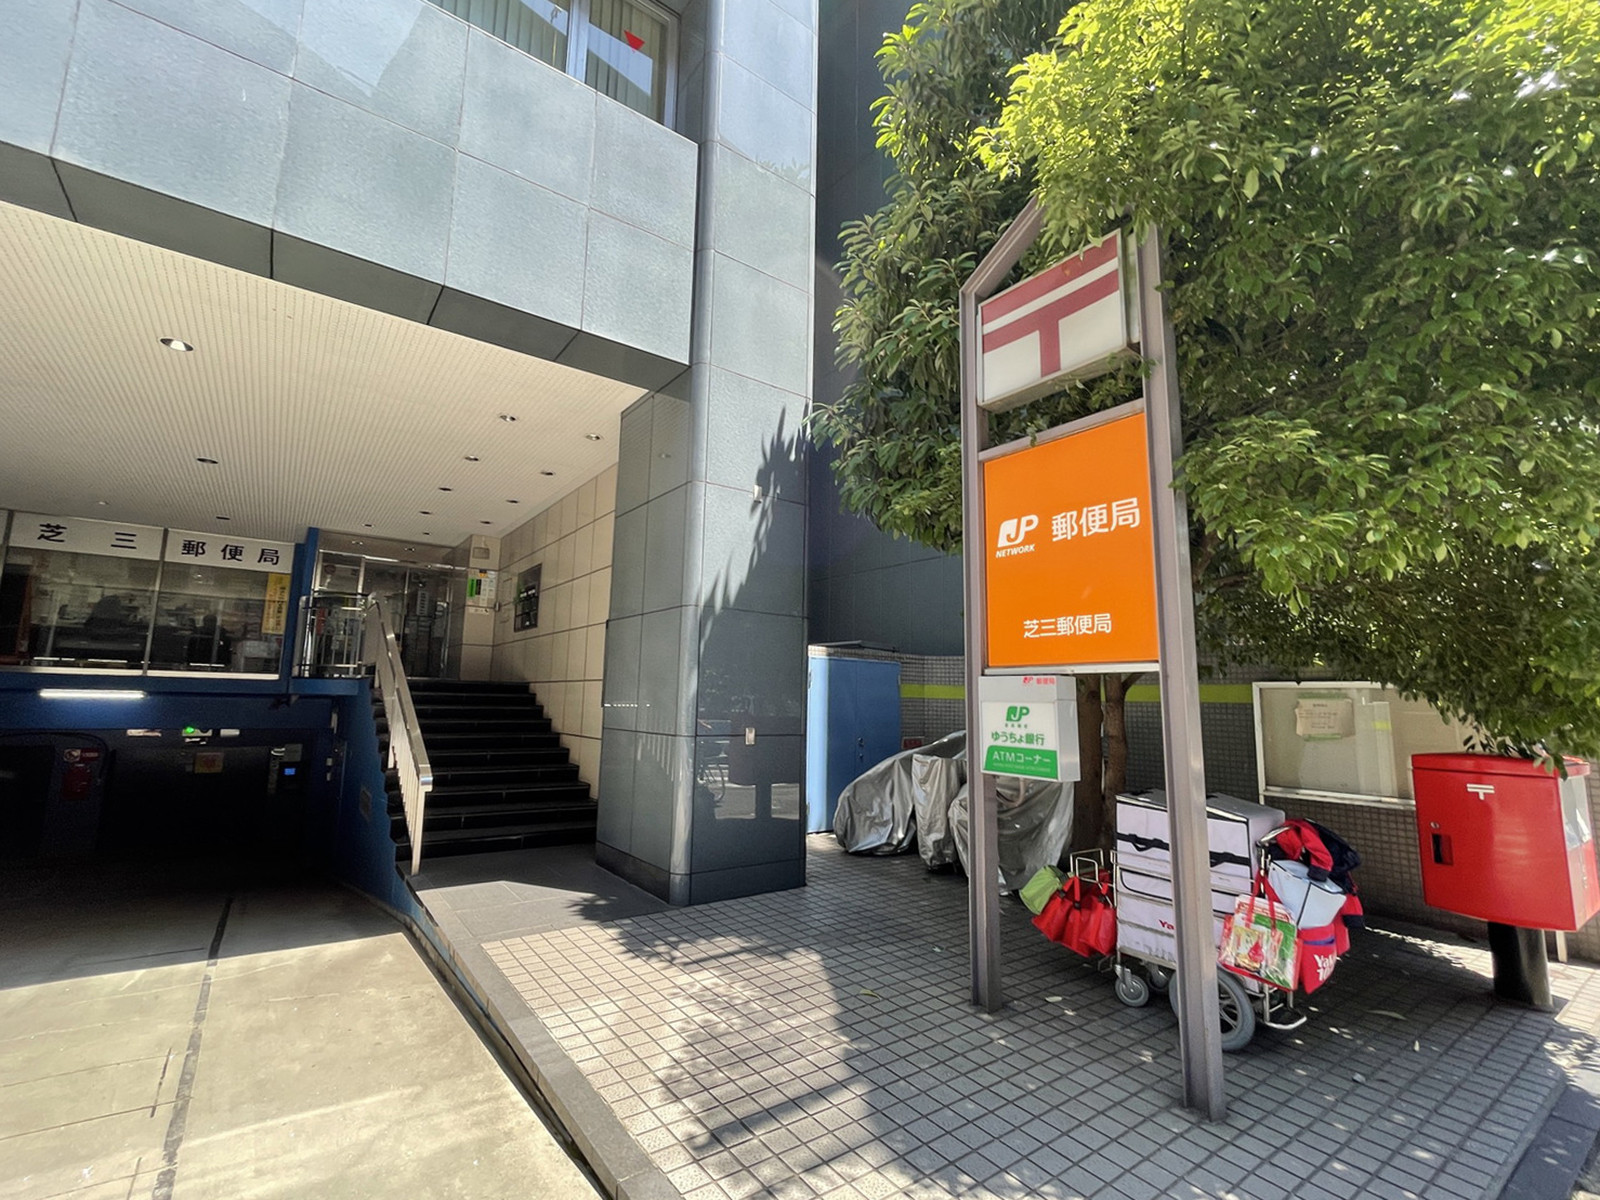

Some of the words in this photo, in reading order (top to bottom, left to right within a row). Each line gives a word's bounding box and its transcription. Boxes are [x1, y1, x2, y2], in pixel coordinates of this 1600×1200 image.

[1051, 497, 1141, 542] 郵便局
[995, 543, 1035, 558] NETWORK
[1023, 613, 1112, 638] 芝三郵便局
[991, 731, 1045, 746] ゆうちょ銀行
[992, 750, 1052, 765] ATMコーナー
